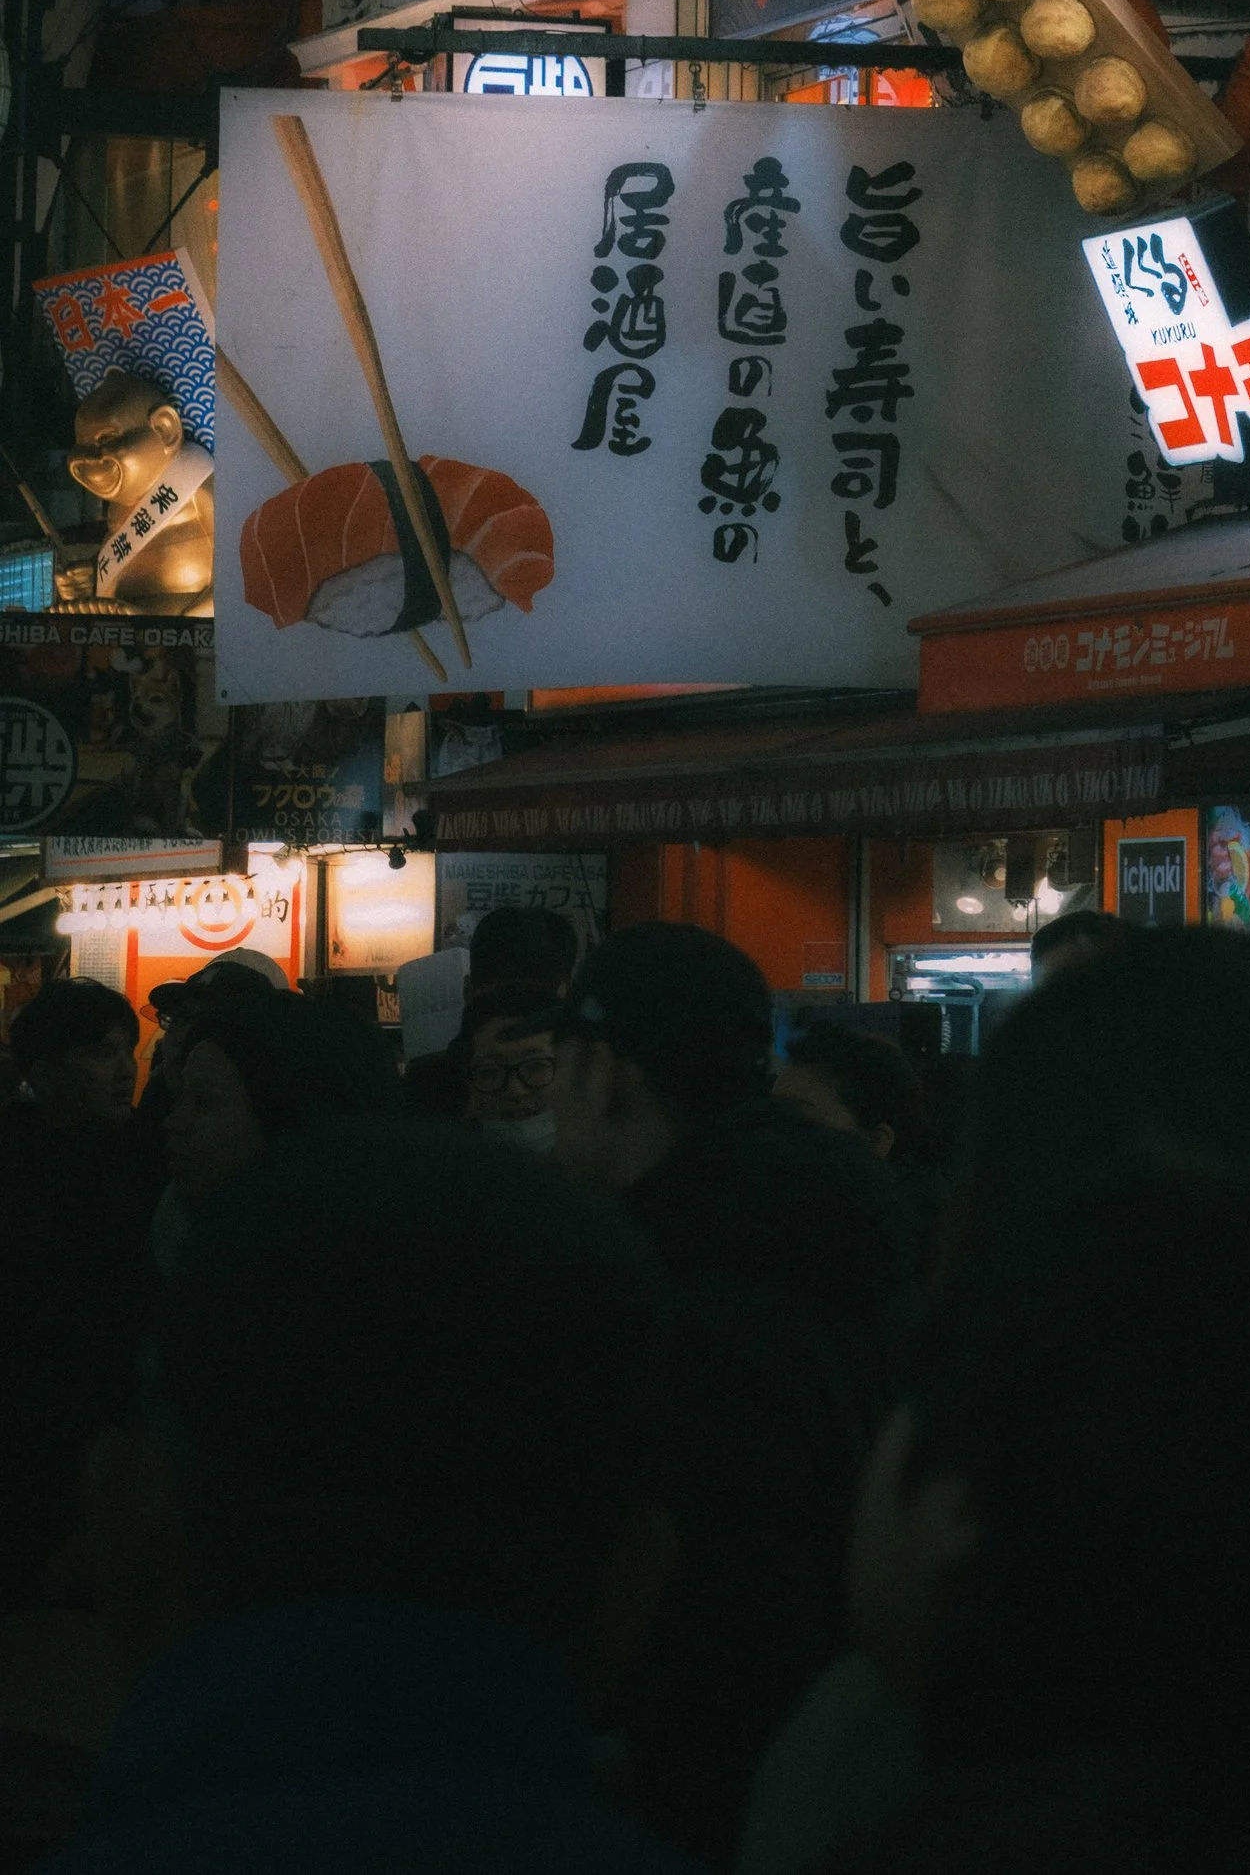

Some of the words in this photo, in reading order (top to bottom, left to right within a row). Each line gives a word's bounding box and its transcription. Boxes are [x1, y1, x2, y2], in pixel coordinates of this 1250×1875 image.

[1122, 233, 1188, 315] くくる
[48, 279, 190, 352] 日本一
[570, 162, 675, 456] 居酒屋
[1150, 322, 1197, 345] KUKURU
[698, 157, 800, 565] 産直の魚の
[70, 625, 135, 646] CAFE
[275, 812, 341, 826] OSAKA
[306, 827, 381, 843] FOREST
[444, 864, 529, 880] MAMESHIBA
[532, 864, 571, 880] CAFE
[261, 890, 289, 923] 的
